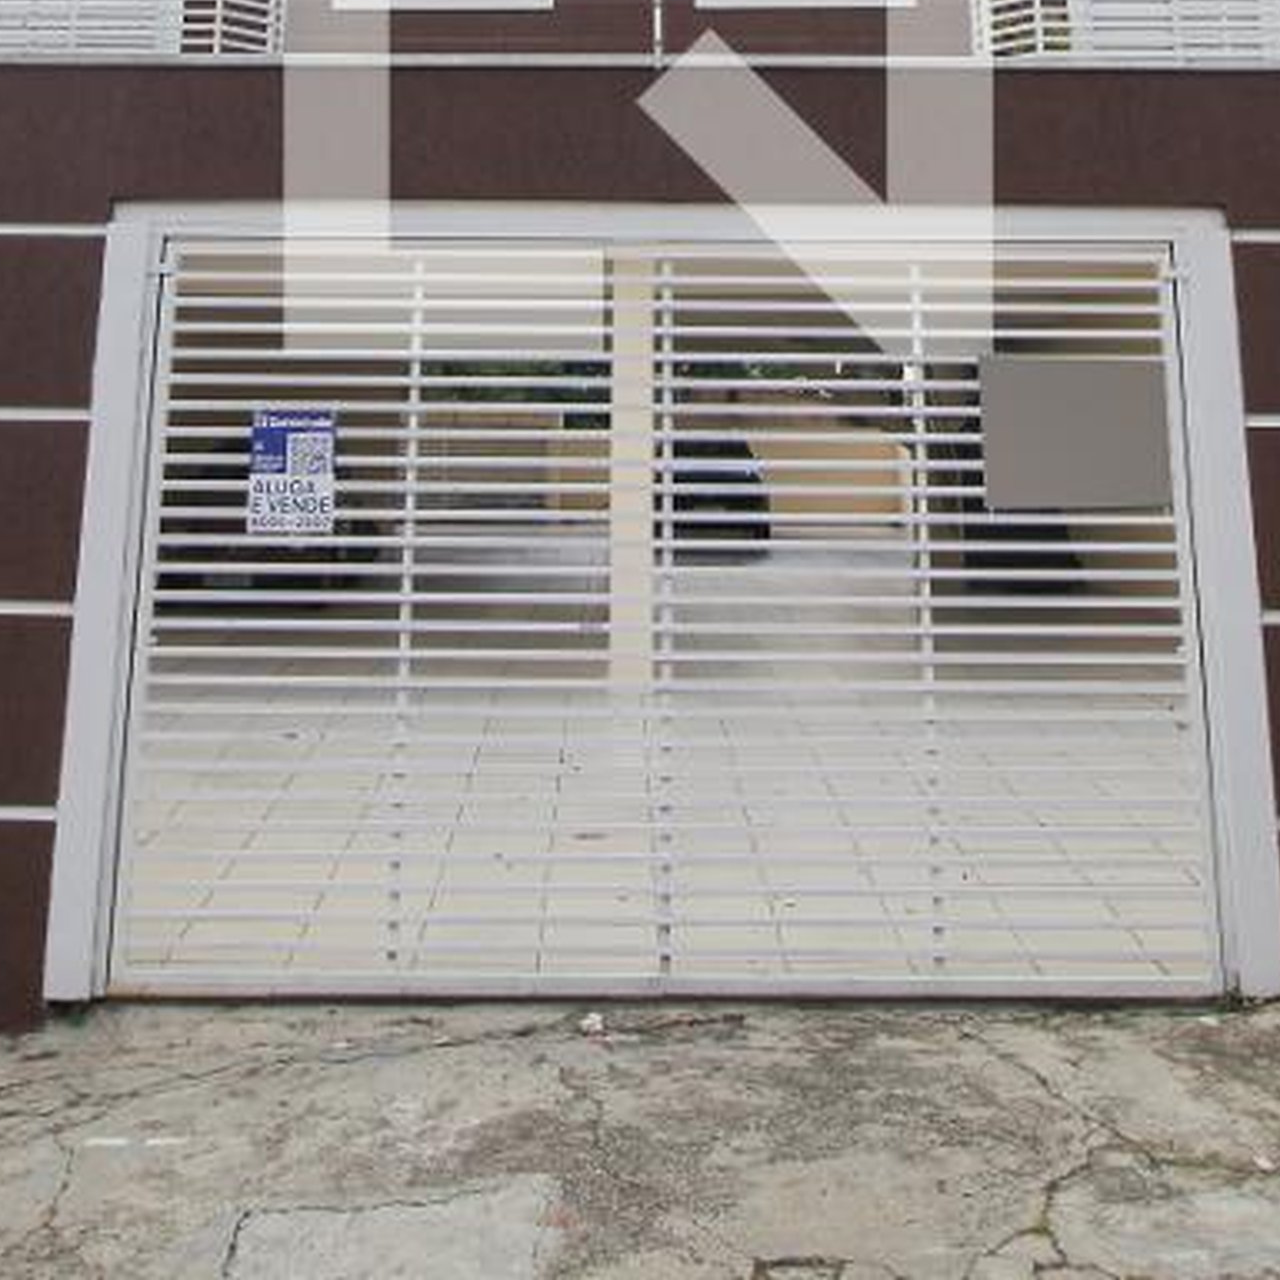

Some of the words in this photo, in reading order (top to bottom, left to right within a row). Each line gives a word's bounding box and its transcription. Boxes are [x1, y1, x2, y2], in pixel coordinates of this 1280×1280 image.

[252, 479, 316, 494] ALUGA
[251, 496, 263, 514] E
[267, 496, 331, 514] VENDE
